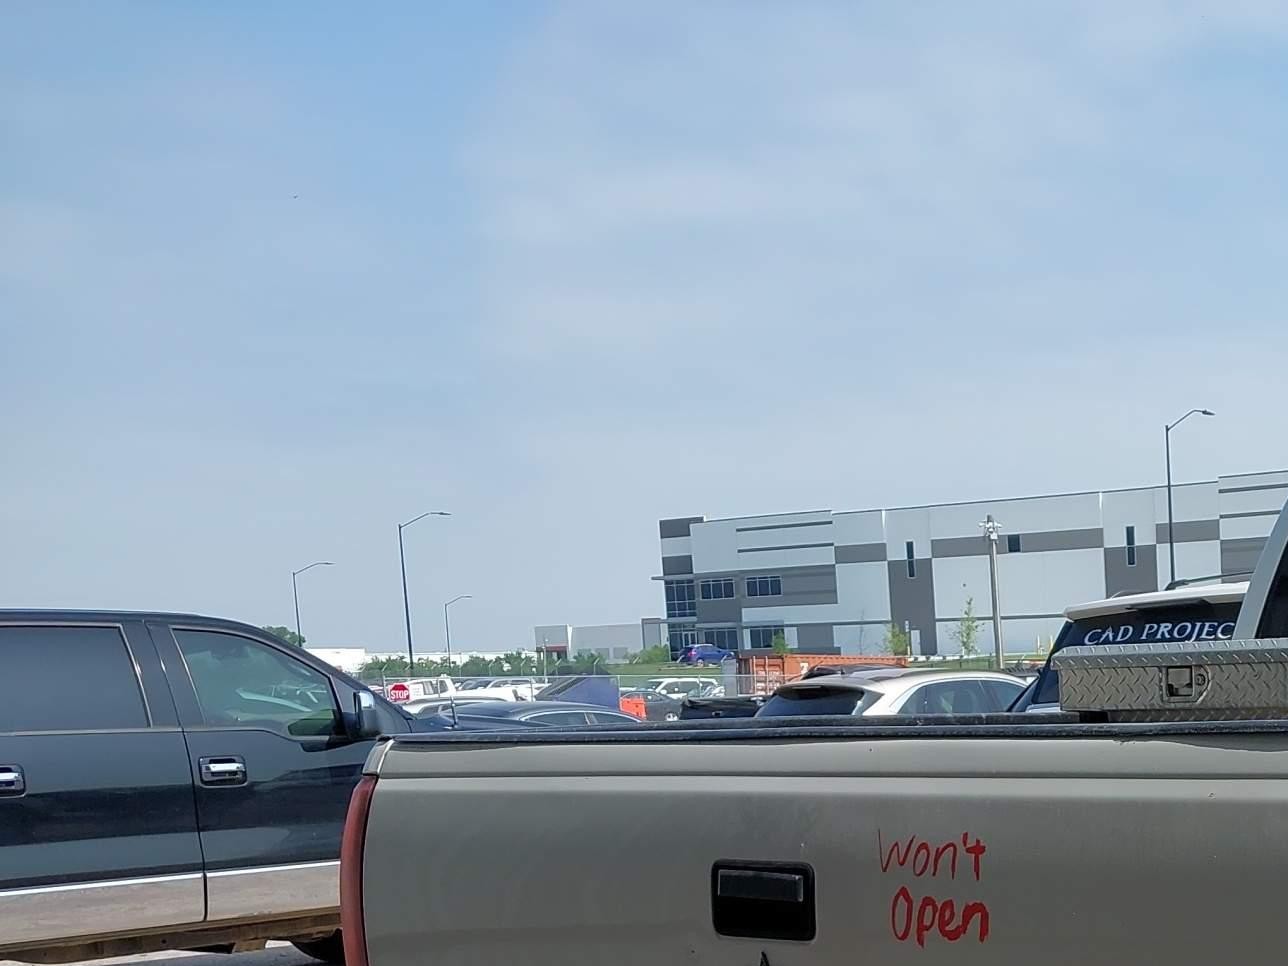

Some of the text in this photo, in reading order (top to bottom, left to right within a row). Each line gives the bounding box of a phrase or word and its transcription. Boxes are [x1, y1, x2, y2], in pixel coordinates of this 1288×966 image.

[1084, 625, 1133, 645] CAD
[390, 690, 409, 700] STOP
[892, 886, 990, 948] Open
